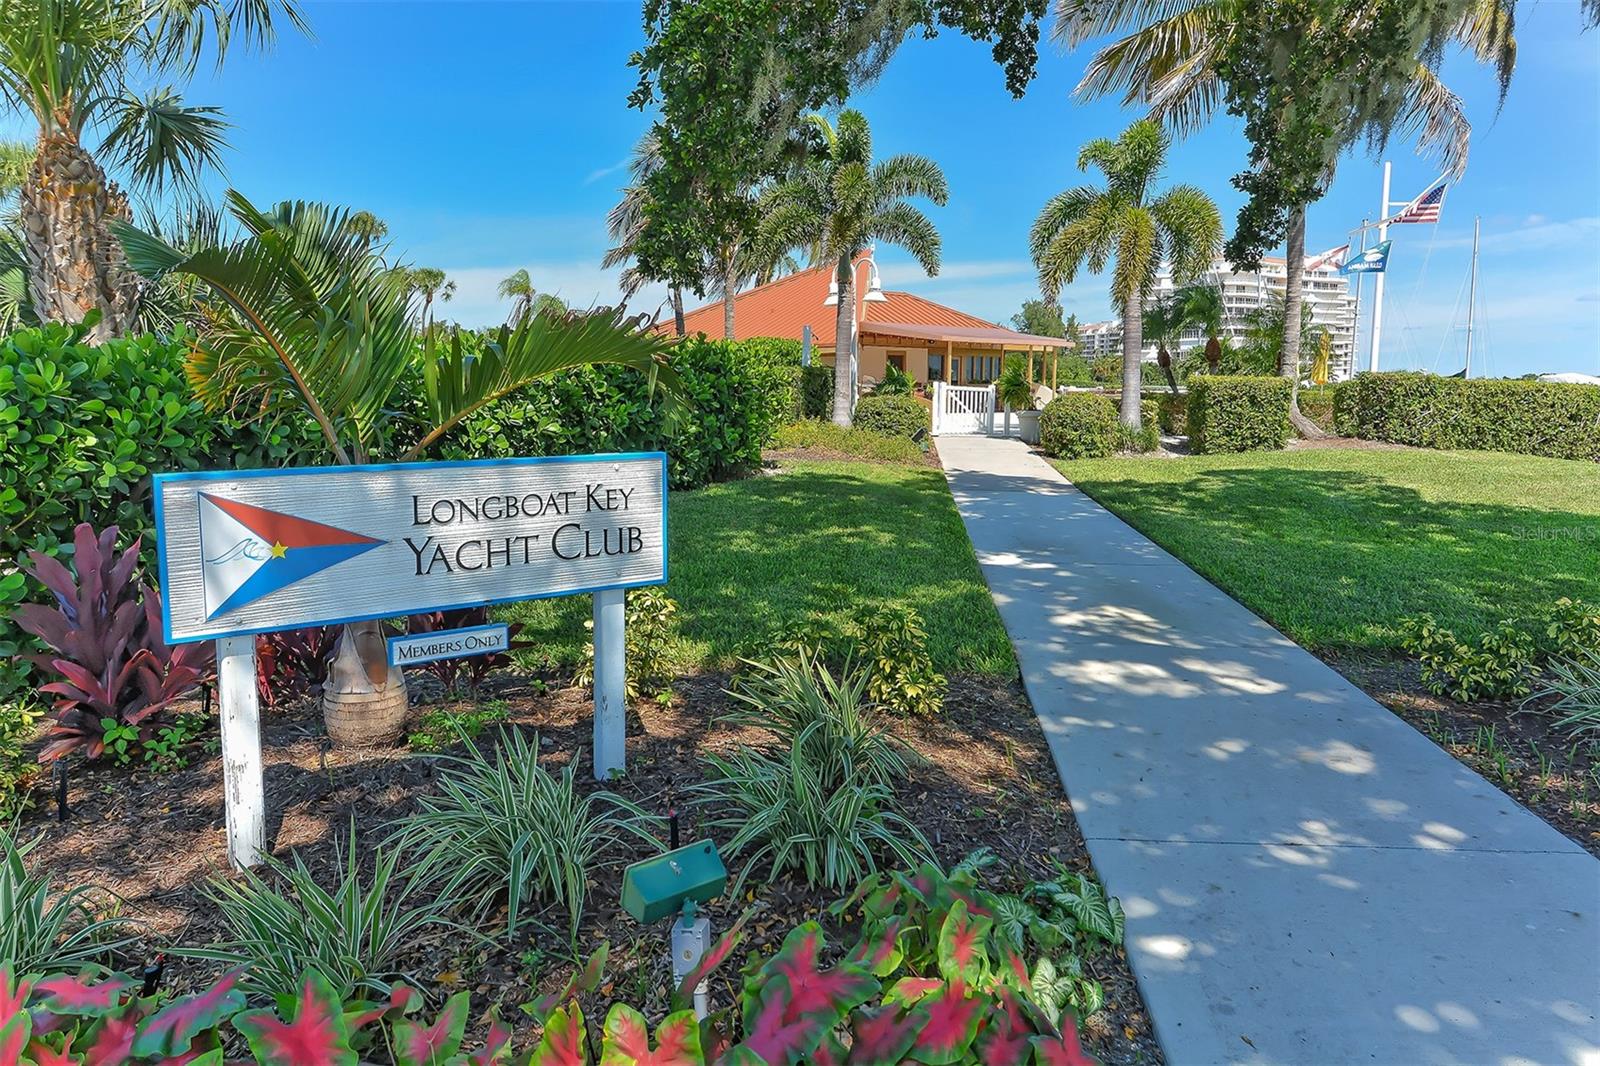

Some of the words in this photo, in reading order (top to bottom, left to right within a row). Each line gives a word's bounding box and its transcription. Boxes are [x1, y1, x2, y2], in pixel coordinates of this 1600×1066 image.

[412, 491, 576, 526] LONGBOAT
[585, 483, 635, 512] KEY
[403, 534, 539, 576] YACHT
[551, 523, 643, 560] CLUB
[398, 640, 462, 660] MEMBERS
[465, 635, 503, 649] ONLY
